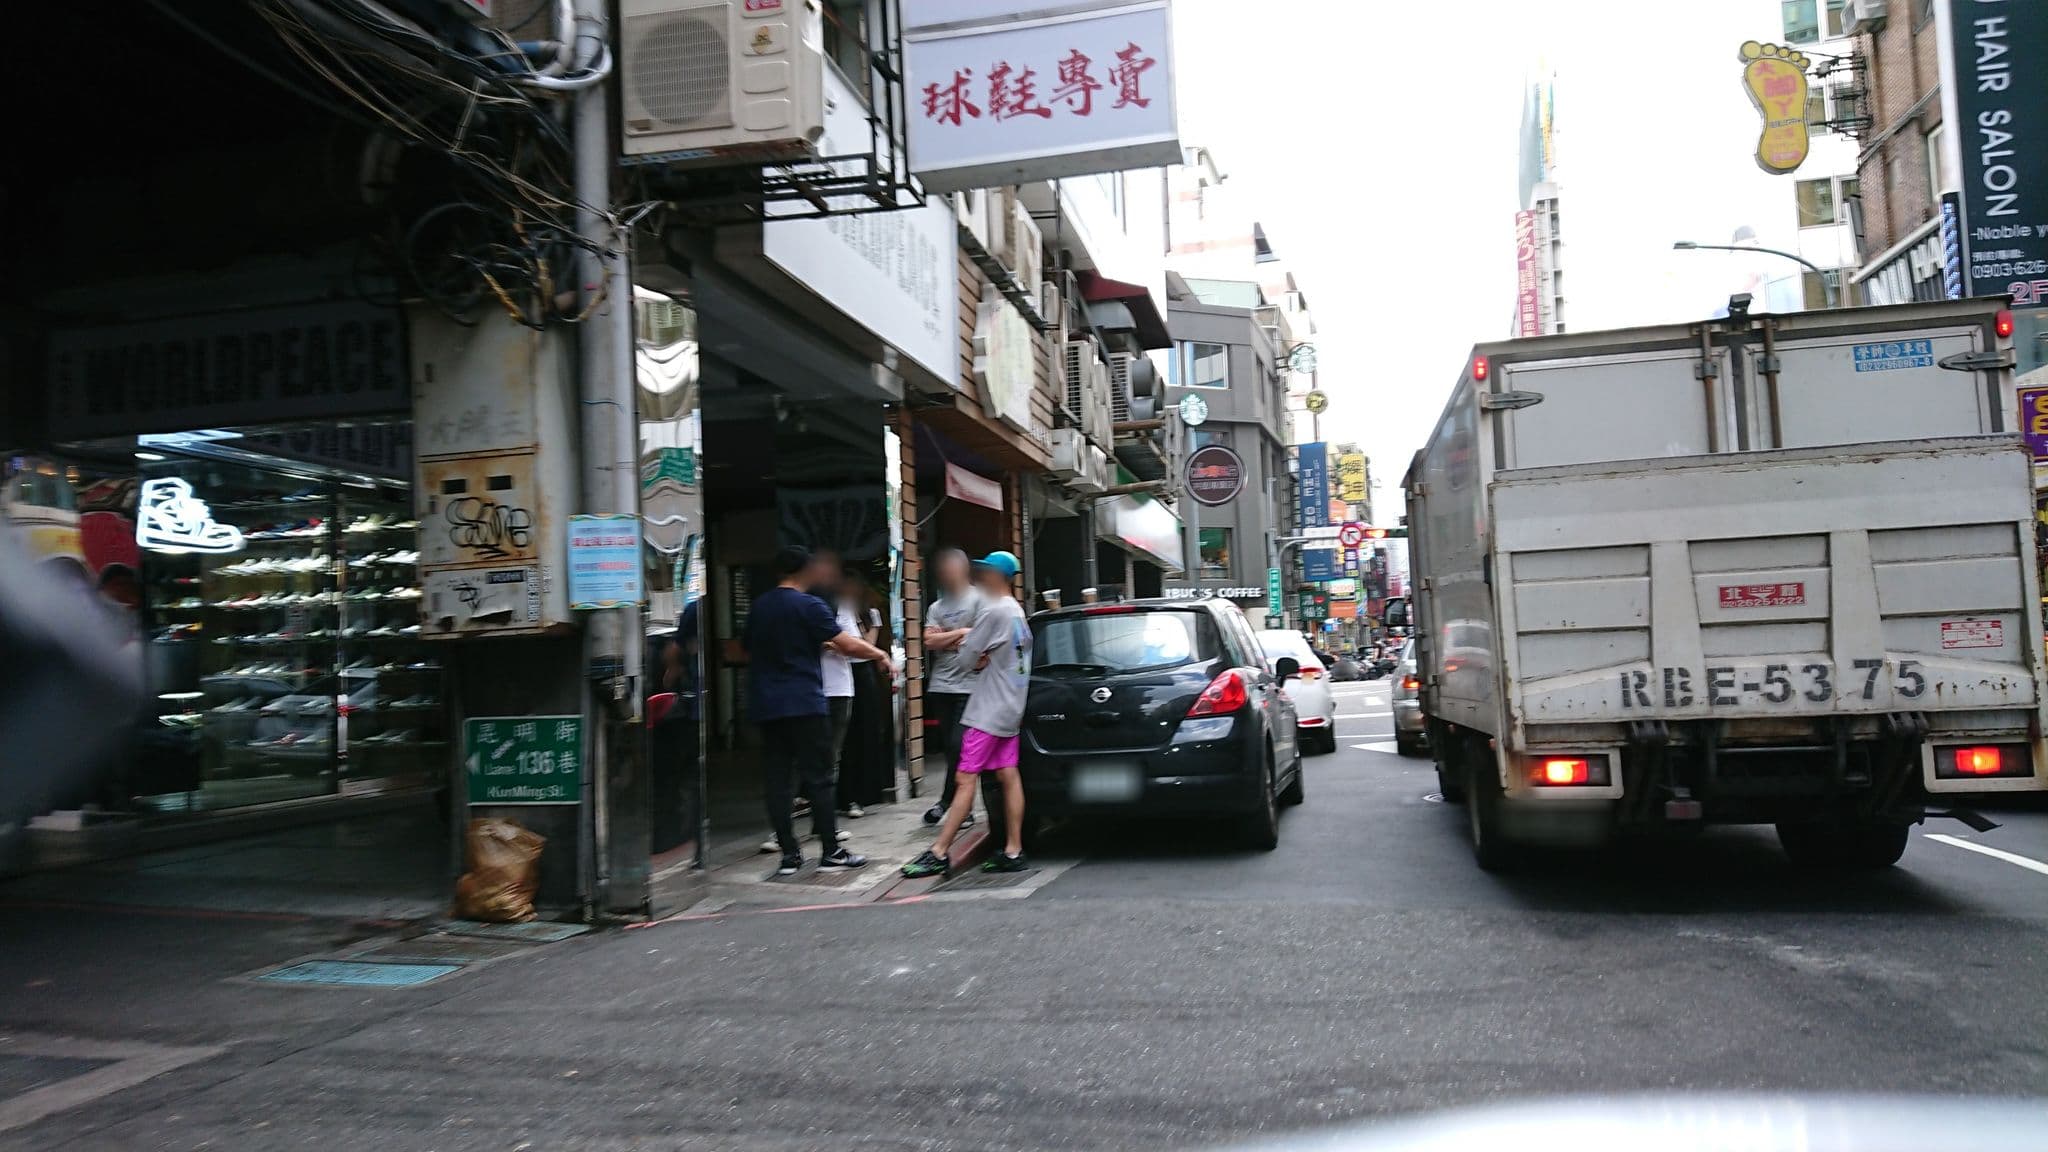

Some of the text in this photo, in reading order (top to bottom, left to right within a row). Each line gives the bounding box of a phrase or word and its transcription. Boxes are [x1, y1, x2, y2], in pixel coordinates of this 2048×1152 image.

[922, 42, 1156, 126] 球鞋專賣
[1974, 16, 2010, 92] HAIR
[1978, 110, 2019, 216] SALON
[1216, 587, 1263, 598] COFFEE
[1620, 657, 1928, 708] RBE-5375
[486, 784, 547, 800] KunMing
